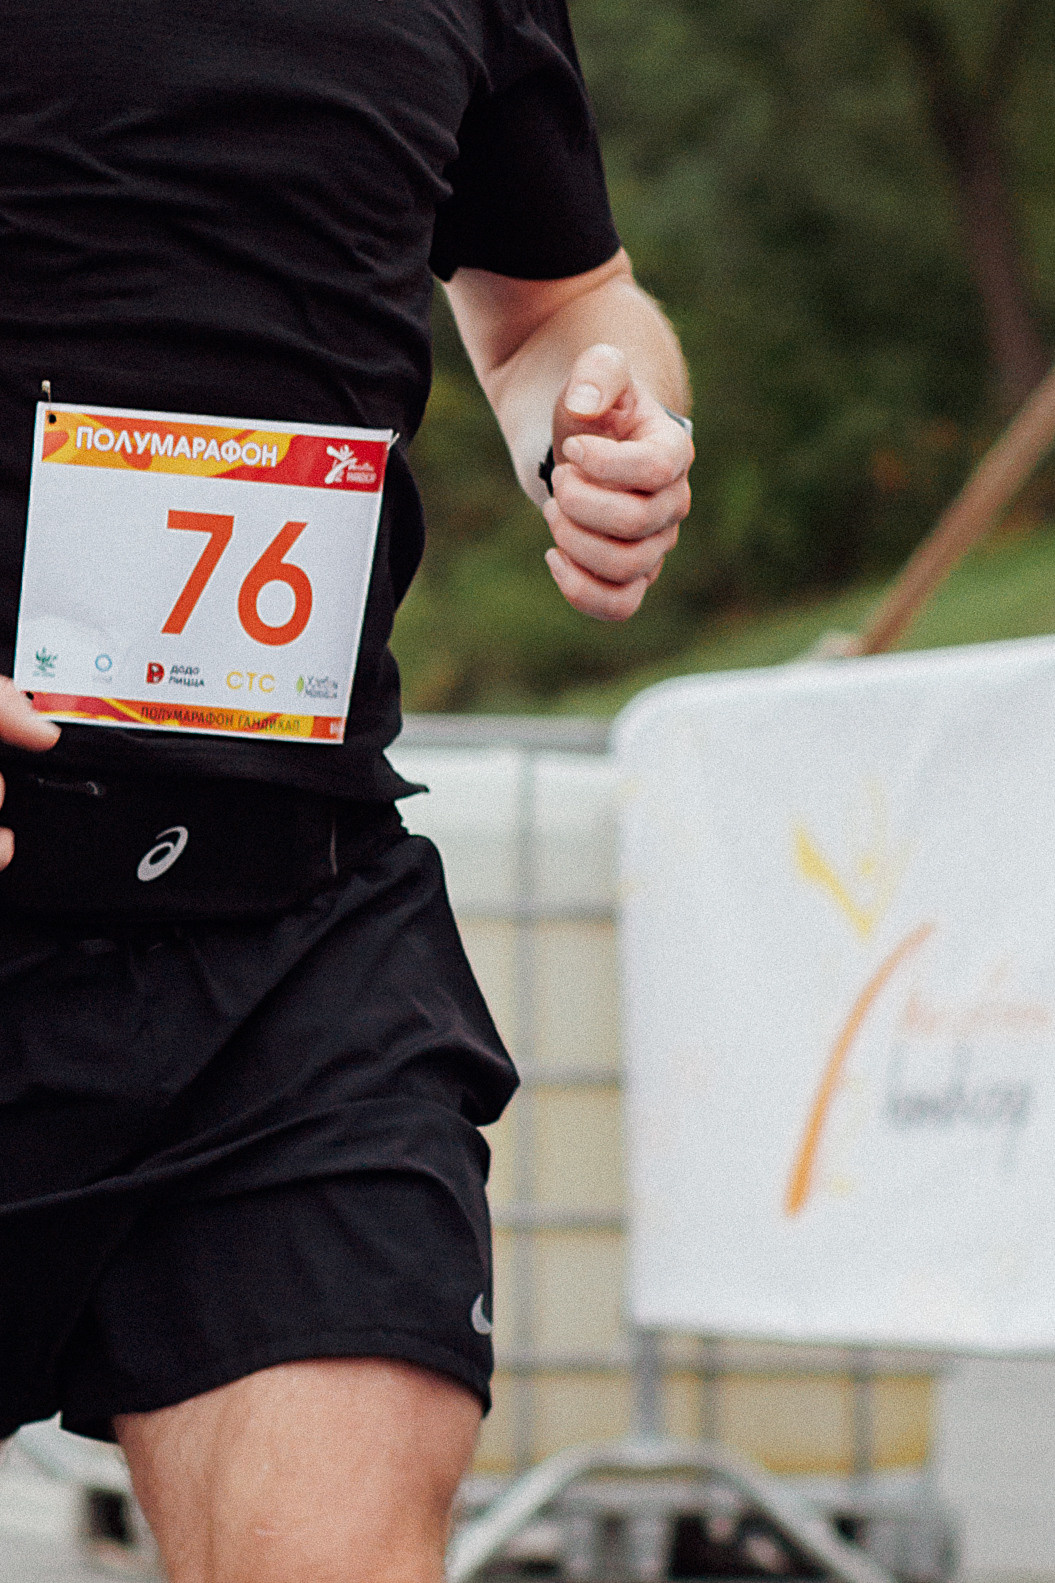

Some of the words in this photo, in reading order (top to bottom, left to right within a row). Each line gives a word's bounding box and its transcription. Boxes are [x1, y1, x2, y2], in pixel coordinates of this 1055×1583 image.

[76, 425, 278, 468] ПОЛУМАРАФОН
[161, 508, 313, 646] 76
[226, 670, 276, 693] СТС
[140, 706, 234, 727] ПОЛУМАРАФОН
